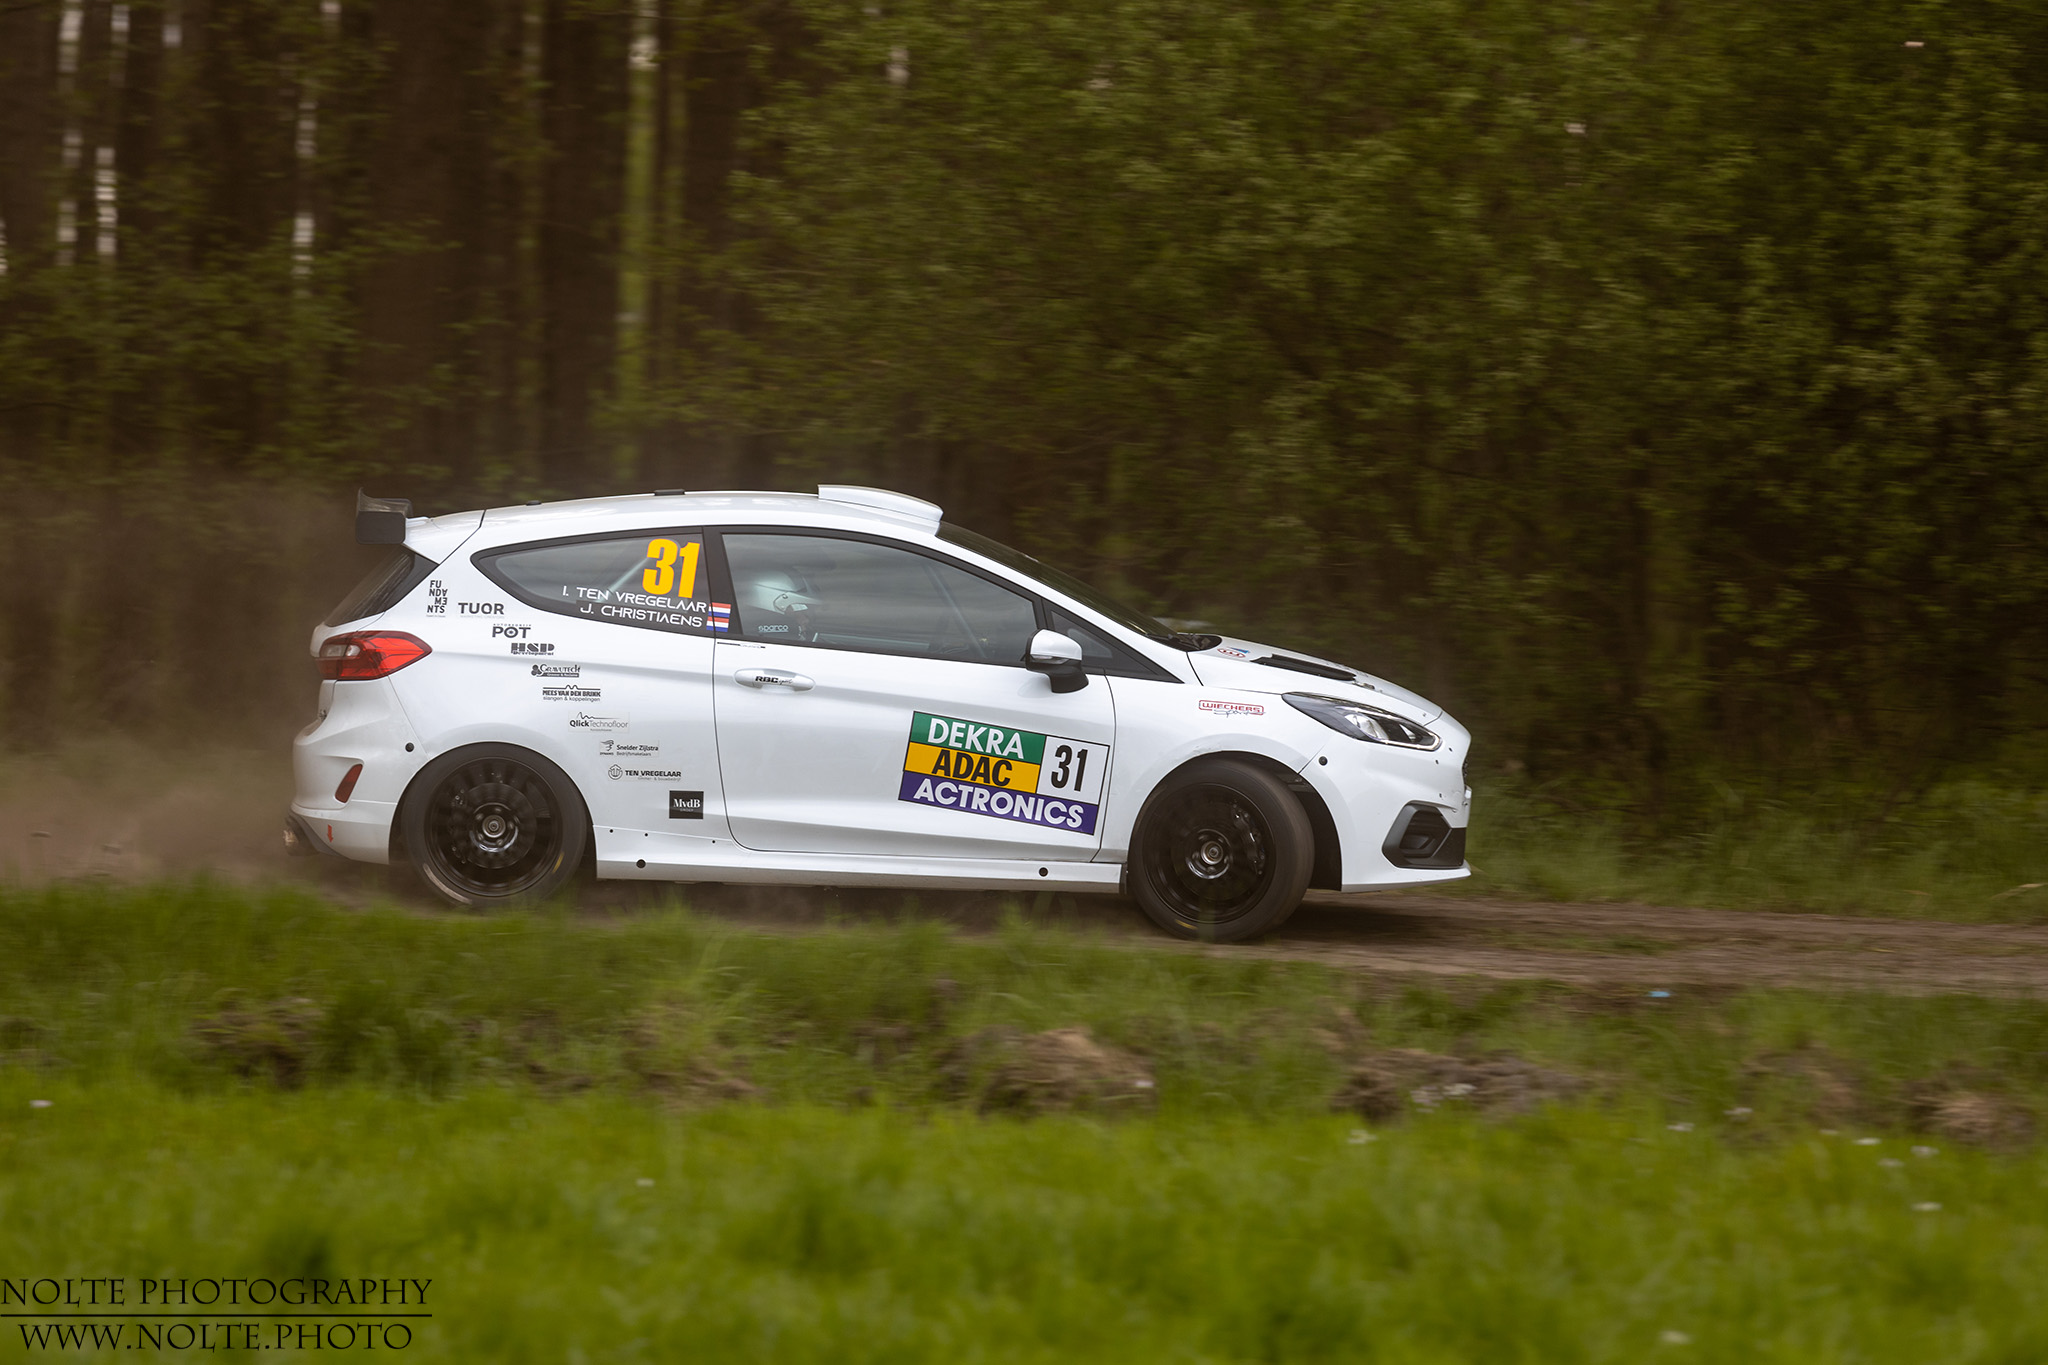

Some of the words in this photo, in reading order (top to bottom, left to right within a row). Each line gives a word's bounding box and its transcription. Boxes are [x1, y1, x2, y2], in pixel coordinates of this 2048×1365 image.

[642, 538, 700, 599] 31
[562, 585, 569, 597] I.
[576, 587, 609, 600] TEN
[616, 591, 707, 613] VREGELAAR
[458, 602, 504, 615] TUOR
[580, 603, 594, 615] J.
[601, 605, 703, 628] CHRISTIAENS
[492, 626, 531, 638] POT
[758, 624, 789, 632] sparco
[511, 642, 555, 653] HSP
[754, 675, 779, 684] RBC
[1202, 702, 1261, 713] WIECHERS
[927, 717, 1024, 759] DEKRA
[639, 744, 659, 752] Zijlstra
[931, 750, 1013, 787] ADAC
[1050, 744, 1088, 792] 31
[673, 798, 701, 808] MvdB
[913, 778, 1084, 828] ACTRONICS
